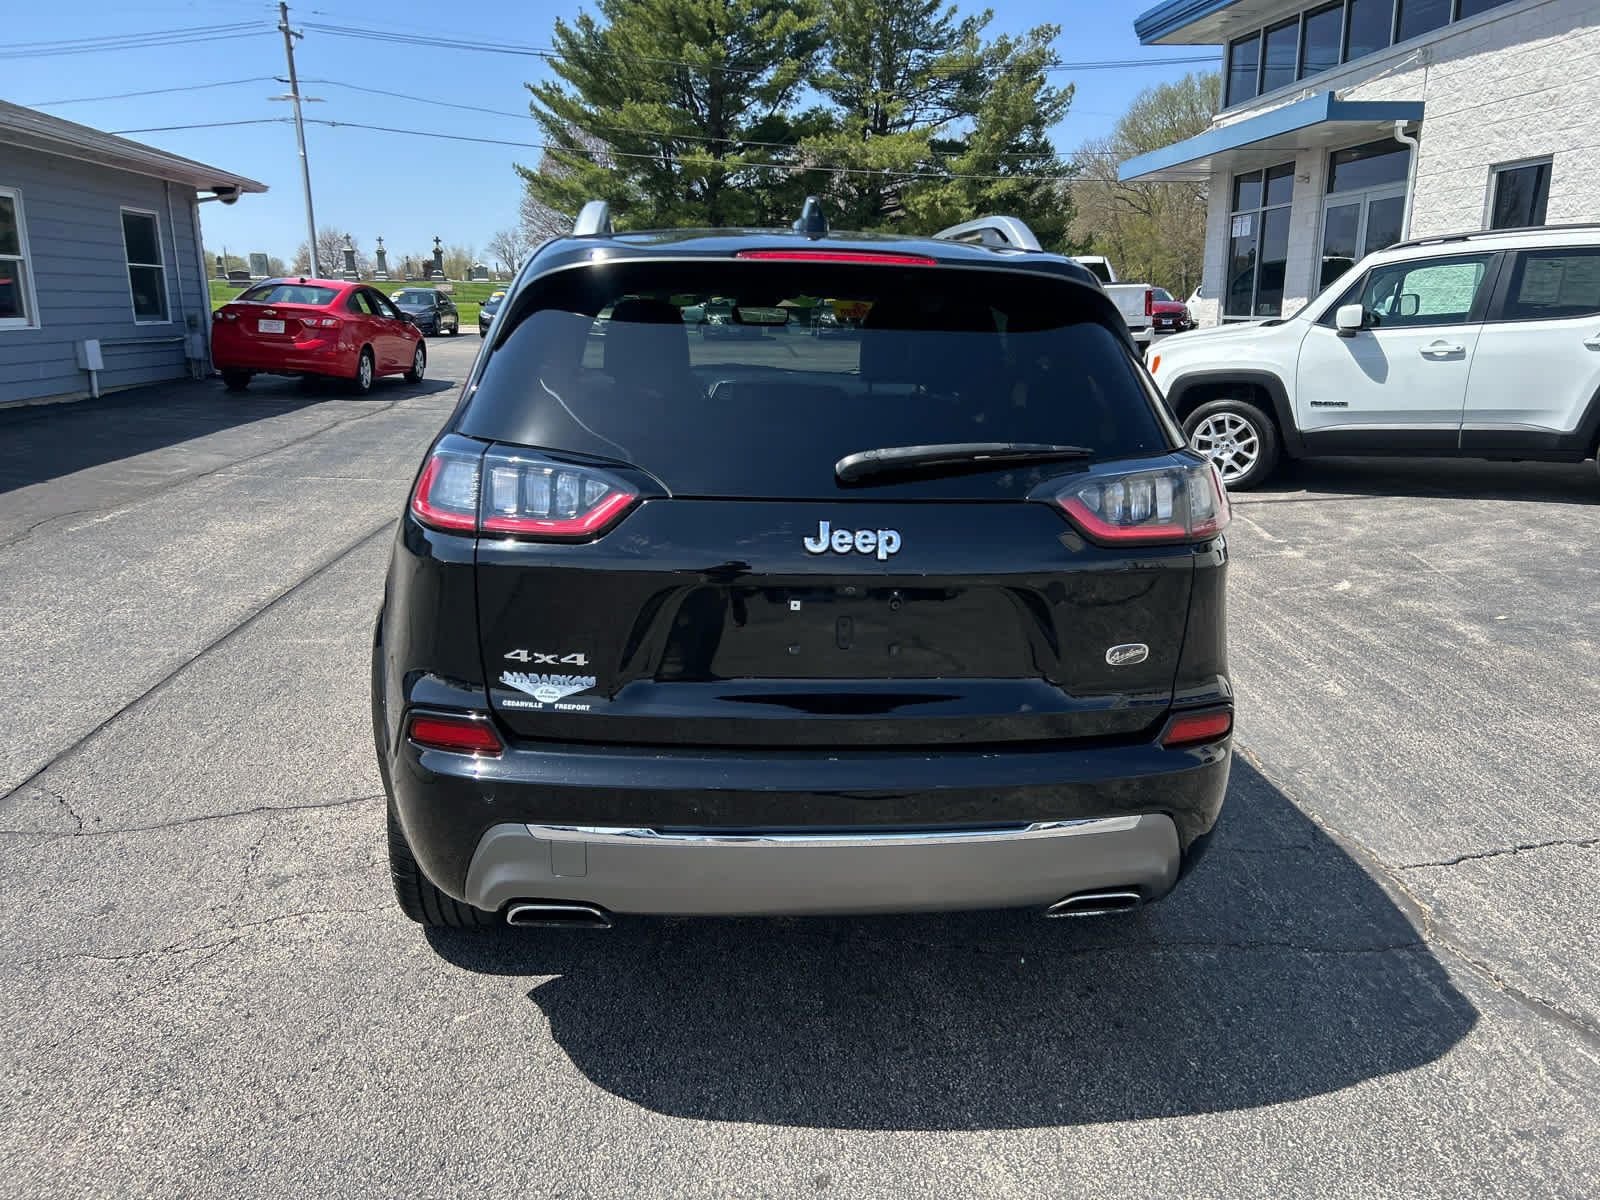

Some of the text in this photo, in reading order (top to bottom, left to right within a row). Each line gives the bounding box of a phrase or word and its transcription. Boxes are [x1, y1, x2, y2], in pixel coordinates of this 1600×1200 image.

[803, 520, 901, 560] Jeep
[503, 648, 589, 666] 4x4
[502, 699, 591, 711] CEDARVILLE FREEPORT
